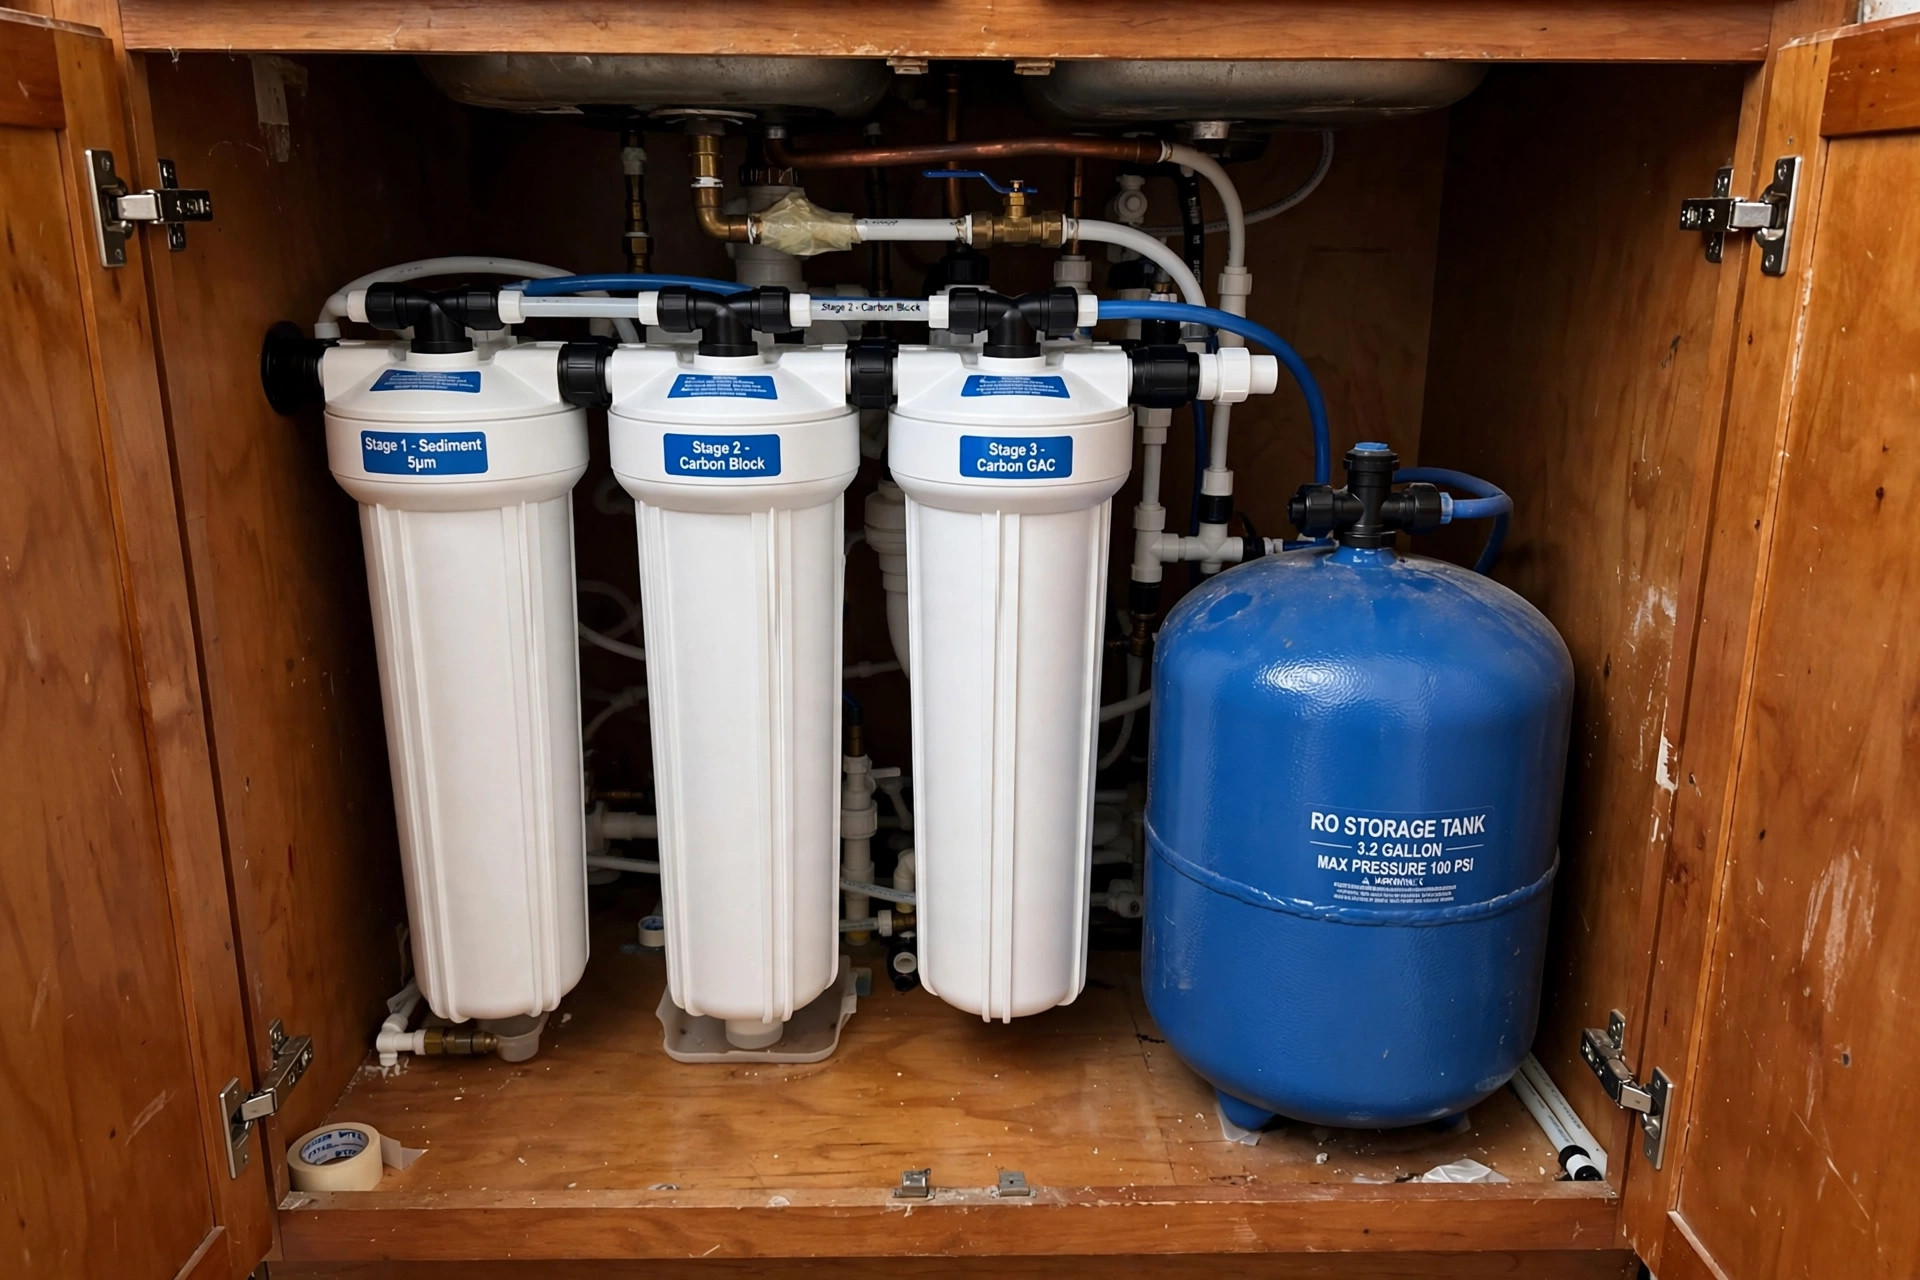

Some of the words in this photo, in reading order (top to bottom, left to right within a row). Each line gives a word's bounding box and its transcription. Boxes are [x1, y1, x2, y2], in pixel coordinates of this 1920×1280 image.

[848, 302, 854, 311] 2
[365, 437, 398, 454] Stage
[400, 438, 407, 452] 1
[418, 438, 482, 452] Sediment
[692, 440, 730, 457] Stage
[732, 441, 741, 454] 2
[989, 442, 1027, 459] Stage
[1029, 442, 1037, 456] 3
[679, 456, 726, 470] Carbon
[729, 457, 766, 470] Block
[976, 458, 1023, 472] Carbon
[1026, 458, 1056, 472] GAC
[1310, 811, 1340, 833] RO
[1344, 816, 1436, 839] STORAGE
[1441, 814, 1487, 838] TANK
[1356, 841, 1378, 857] 3.2
[1381, 842, 1442, 858] GALLON
[1317, 854, 1348, 872] MAX
[1351, 859, 1427, 876] PRESSURE
[1430, 860, 1451, 875] 100
[1454, 857, 1474, 873] PSI
